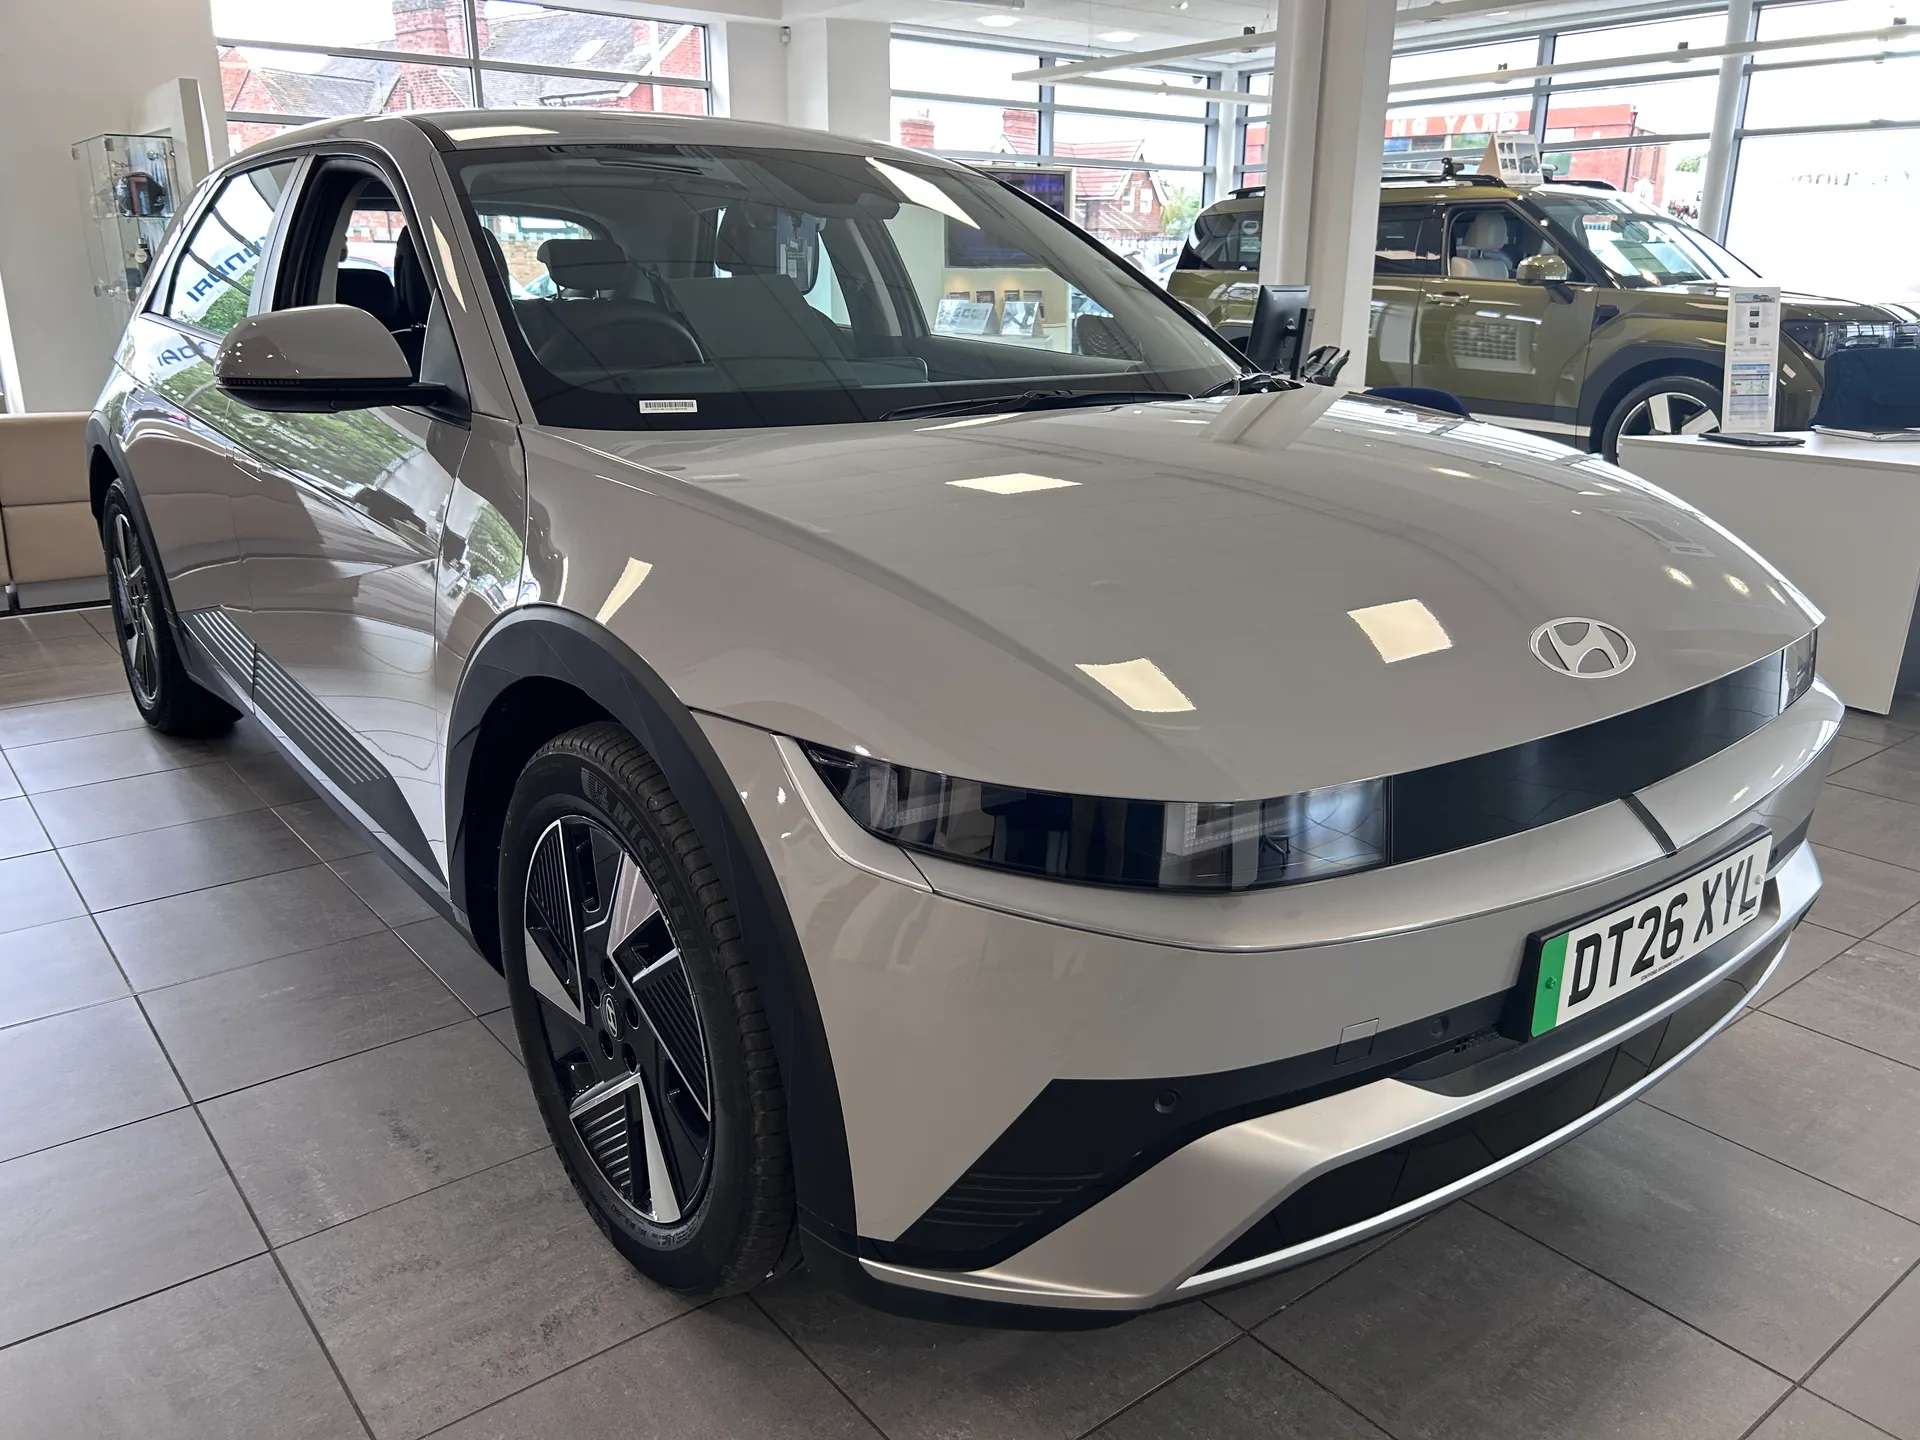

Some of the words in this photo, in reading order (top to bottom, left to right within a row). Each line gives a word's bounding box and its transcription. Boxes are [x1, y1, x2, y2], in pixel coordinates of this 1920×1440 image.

[1444, 112, 1519, 134] YARD
[1568, 893, 1688, 1007] DT26
[1694, 854, 1757, 943] XYL
